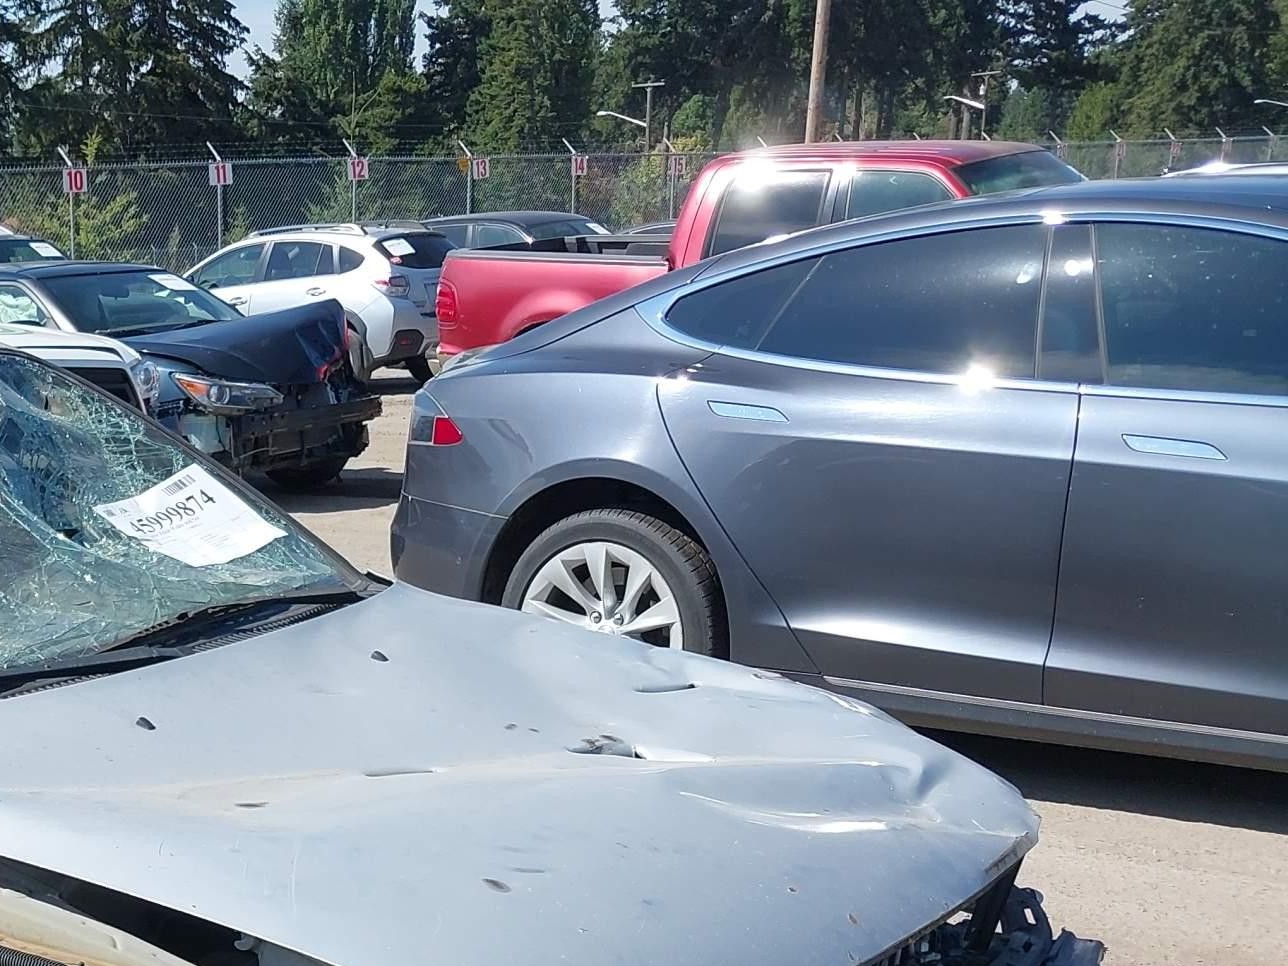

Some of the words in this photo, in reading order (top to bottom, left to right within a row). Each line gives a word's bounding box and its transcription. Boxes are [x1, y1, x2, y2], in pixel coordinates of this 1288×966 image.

[215, 164, 227, 184] 11
[351, 160, 366, 179] 12
[476, 160, 487, 178] 13
[575, 158, 584, 173] 14
[674, 158, 684, 173] 15
[67, 171, 83, 191] 10
[129, 489, 216, 534] 45999874
